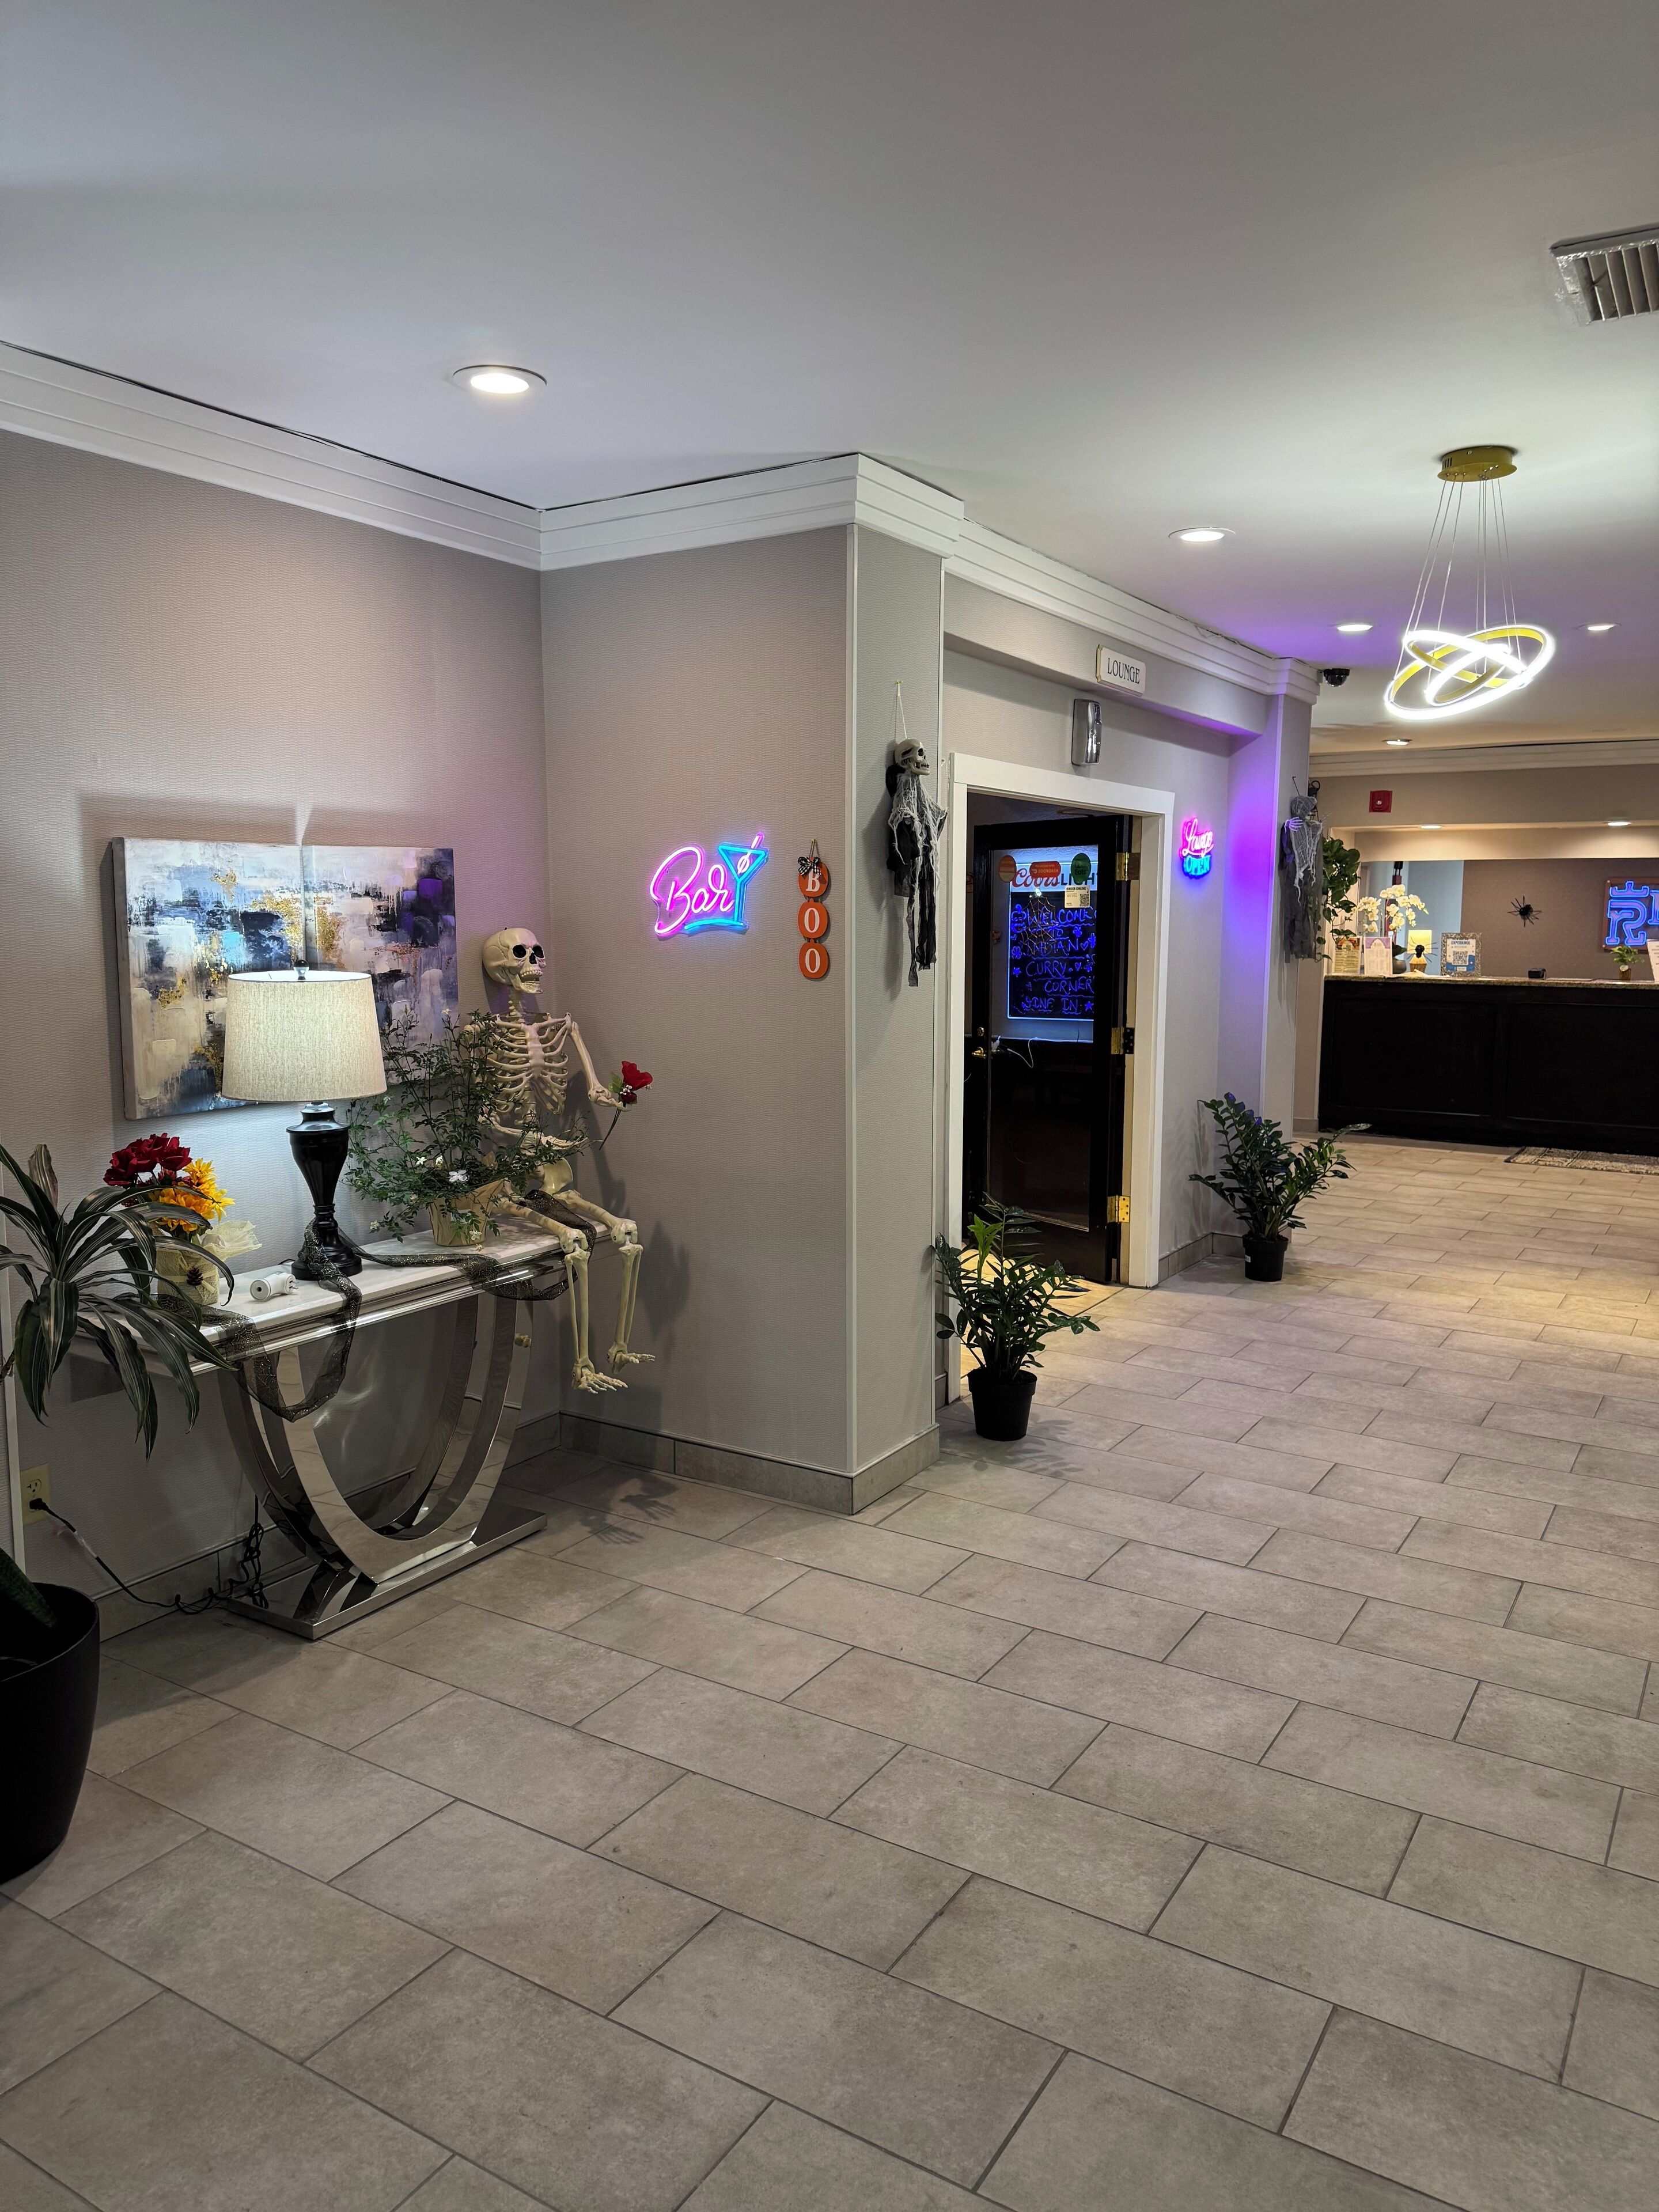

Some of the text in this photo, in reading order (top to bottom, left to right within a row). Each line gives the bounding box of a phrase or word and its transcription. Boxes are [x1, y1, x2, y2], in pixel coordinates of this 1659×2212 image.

[1107, 658, 1140, 684] LOUNGE
[1185, 855, 1211, 876] OPEN
[650, 846, 734, 934] Bar
[1026, 960, 1066, 979] CURRY
[1044, 976, 1094, 996] CORNER
